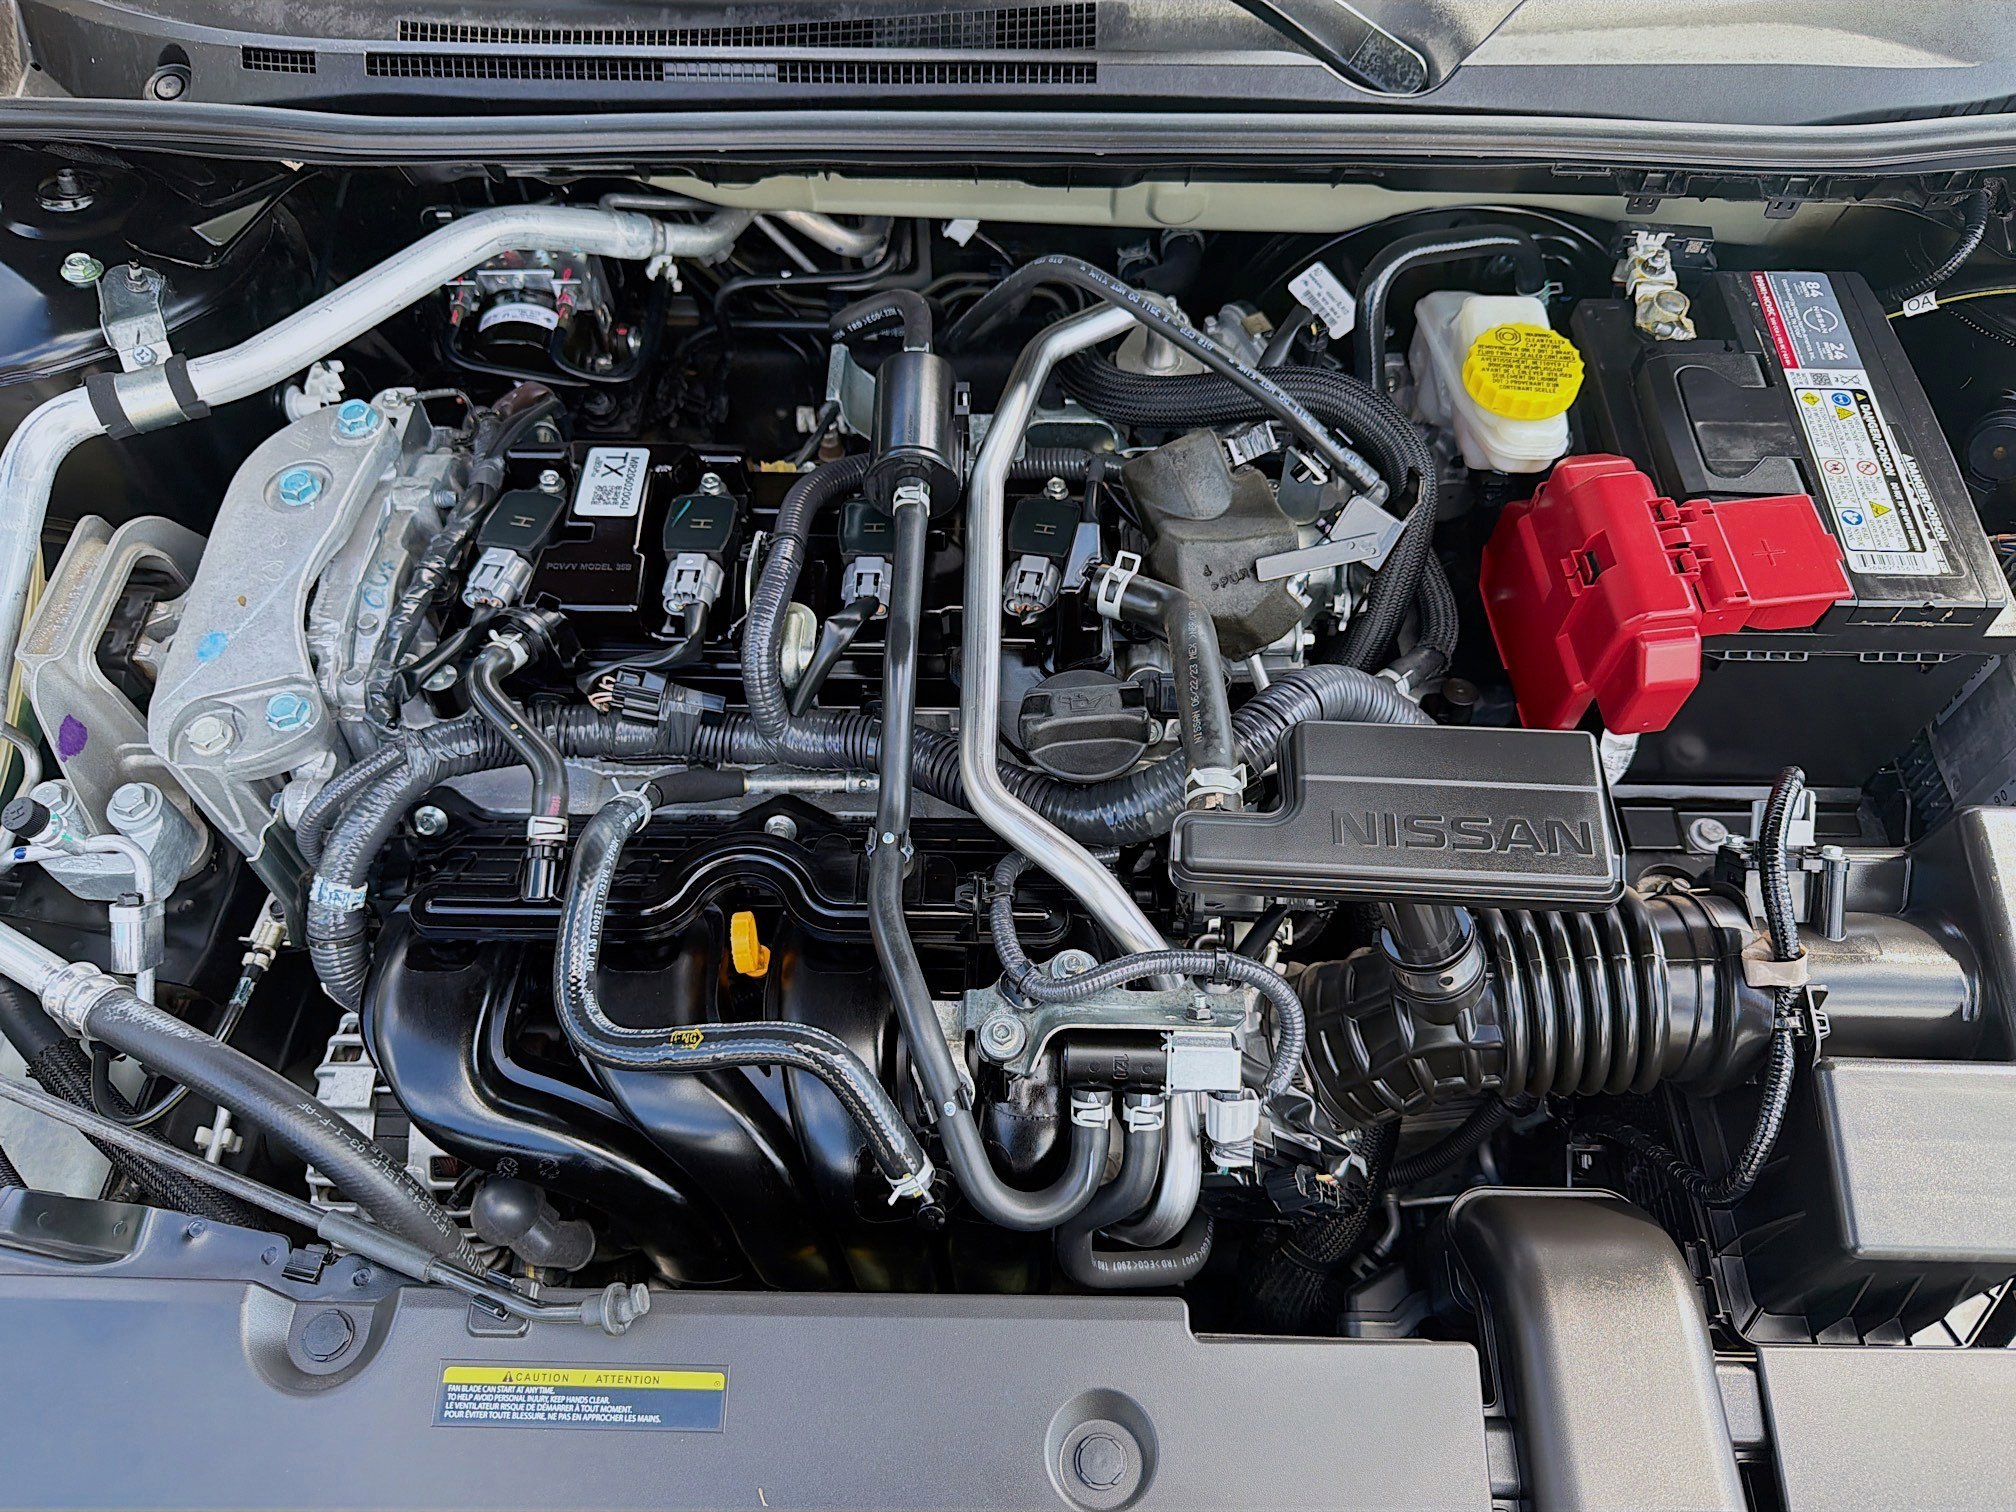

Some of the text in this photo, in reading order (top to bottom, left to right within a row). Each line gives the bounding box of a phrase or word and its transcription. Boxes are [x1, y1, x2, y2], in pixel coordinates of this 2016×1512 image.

[1804, 281, 1824, 297] 84
[1908, 295, 1933, 311] OA
[1811, 305, 1828, 333] NISSAN
[1828, 342, 1849, 360] 24
[1858, 403, 1897, 476] DANGER/POISON
[600, 452, 628, 477] TX
[1905, 461, 1949, 541] DANGER/POISON
[1188, 663, 1199, 706] 06/22/23
[1191, 710, 1203, 744] NISSAN
[1331, 810, 1597, 858] NISSAN
[372, 1158, 401, 1185] 15LP
[408, 1189, 451, 1238] HFC134a
[516, 1372, 570, 1382] CAUTION
[595, 1375, 660, 1385] ATTENTION
[447, 1393, 456, 1401] TO
[455, 1402, 499, 1410] VENTILATEUR
[500, 1403, 525, 1411] RISQUE
[537, 1403, 573, 1411] DÉMARRER
[581, 1404, 599, 1412] TOUT
[600, 1405, 633, 1413] MOMENT.
[465, 1410, 488, 1418] ÉVITER
[489, 1411, 510, 1419] TOUTE
[572, 1413, 581, 1421] EN
[637, 1415, 661, 1423] MAINS.
